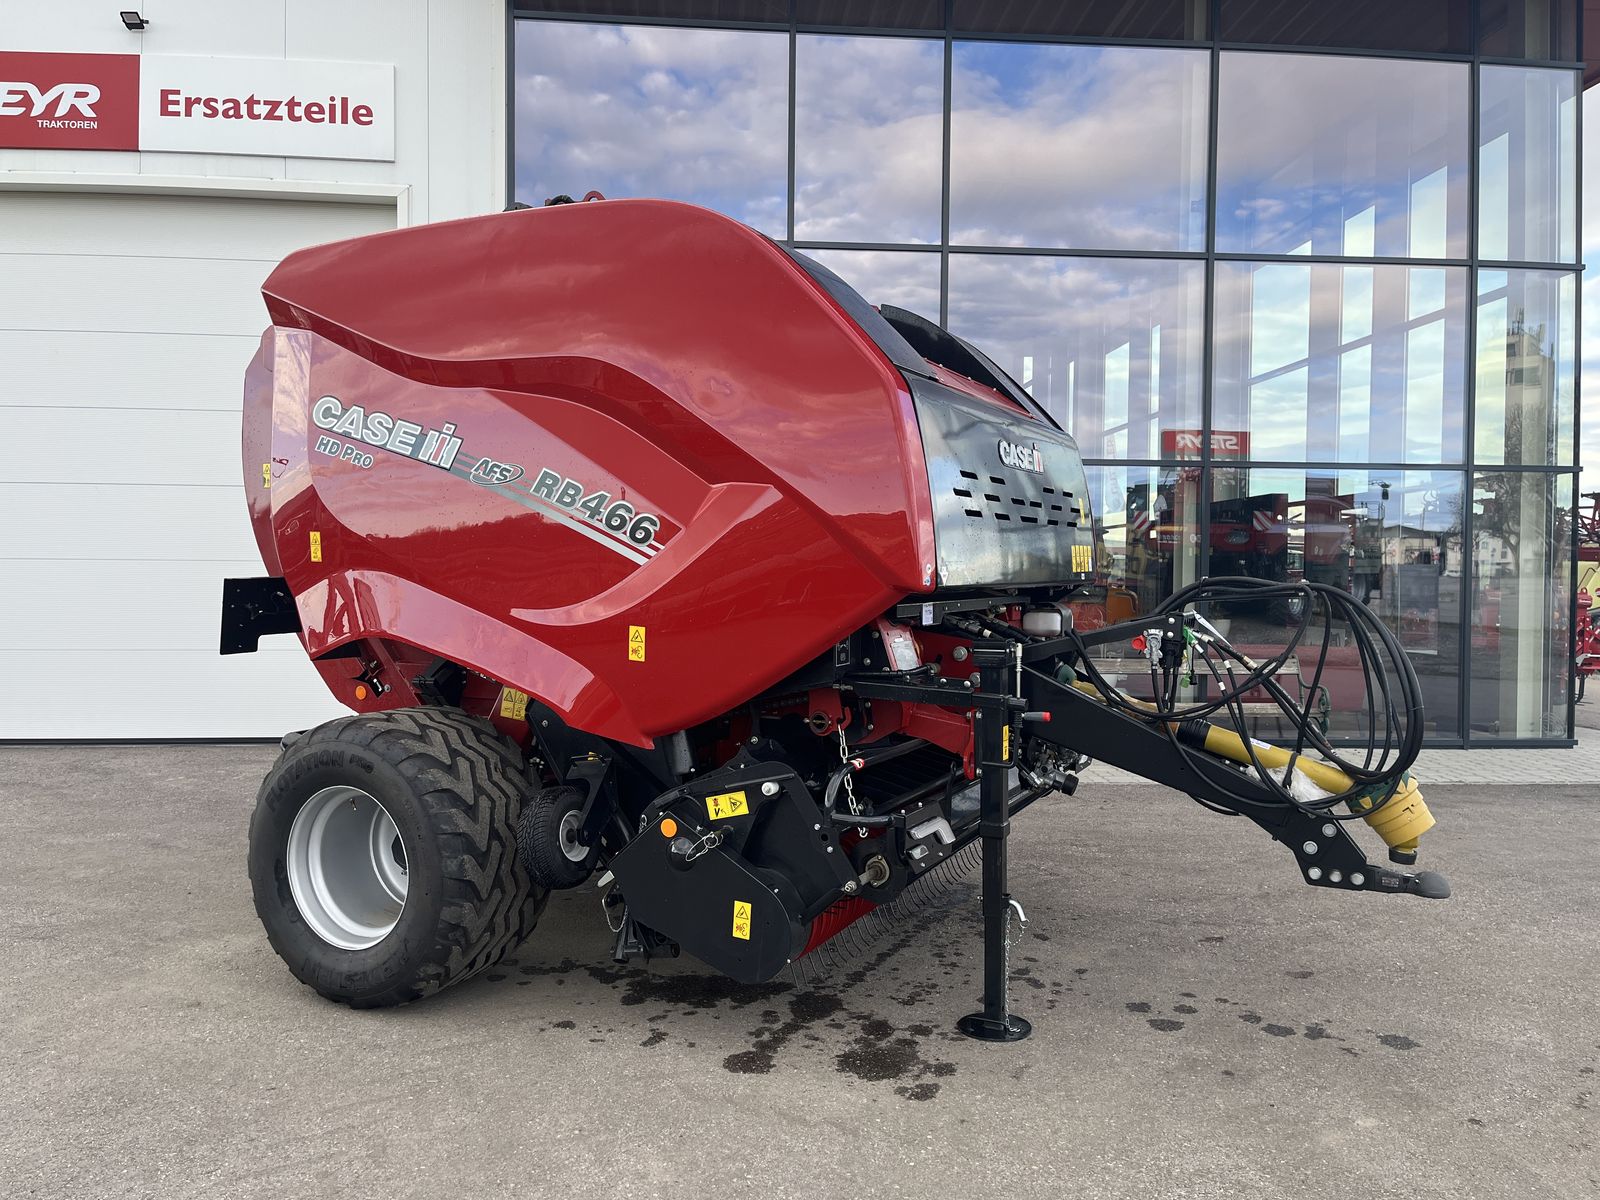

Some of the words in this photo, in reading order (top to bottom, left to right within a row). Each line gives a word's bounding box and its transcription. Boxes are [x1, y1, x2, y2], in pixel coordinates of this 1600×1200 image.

[37, 120, 98, 129] TRAKTOREN
[159, 88, 374, 126] Ersatzteile
[312, 396, 423, 456] CASE
[315, 435, 342, 456] HD
[998, 439, 1034, 471] CASE
[470, 457, 514, 483] AFS
[530, 467, 661, 547] RB466
[264, 750, 346, 812] FLOTATION
